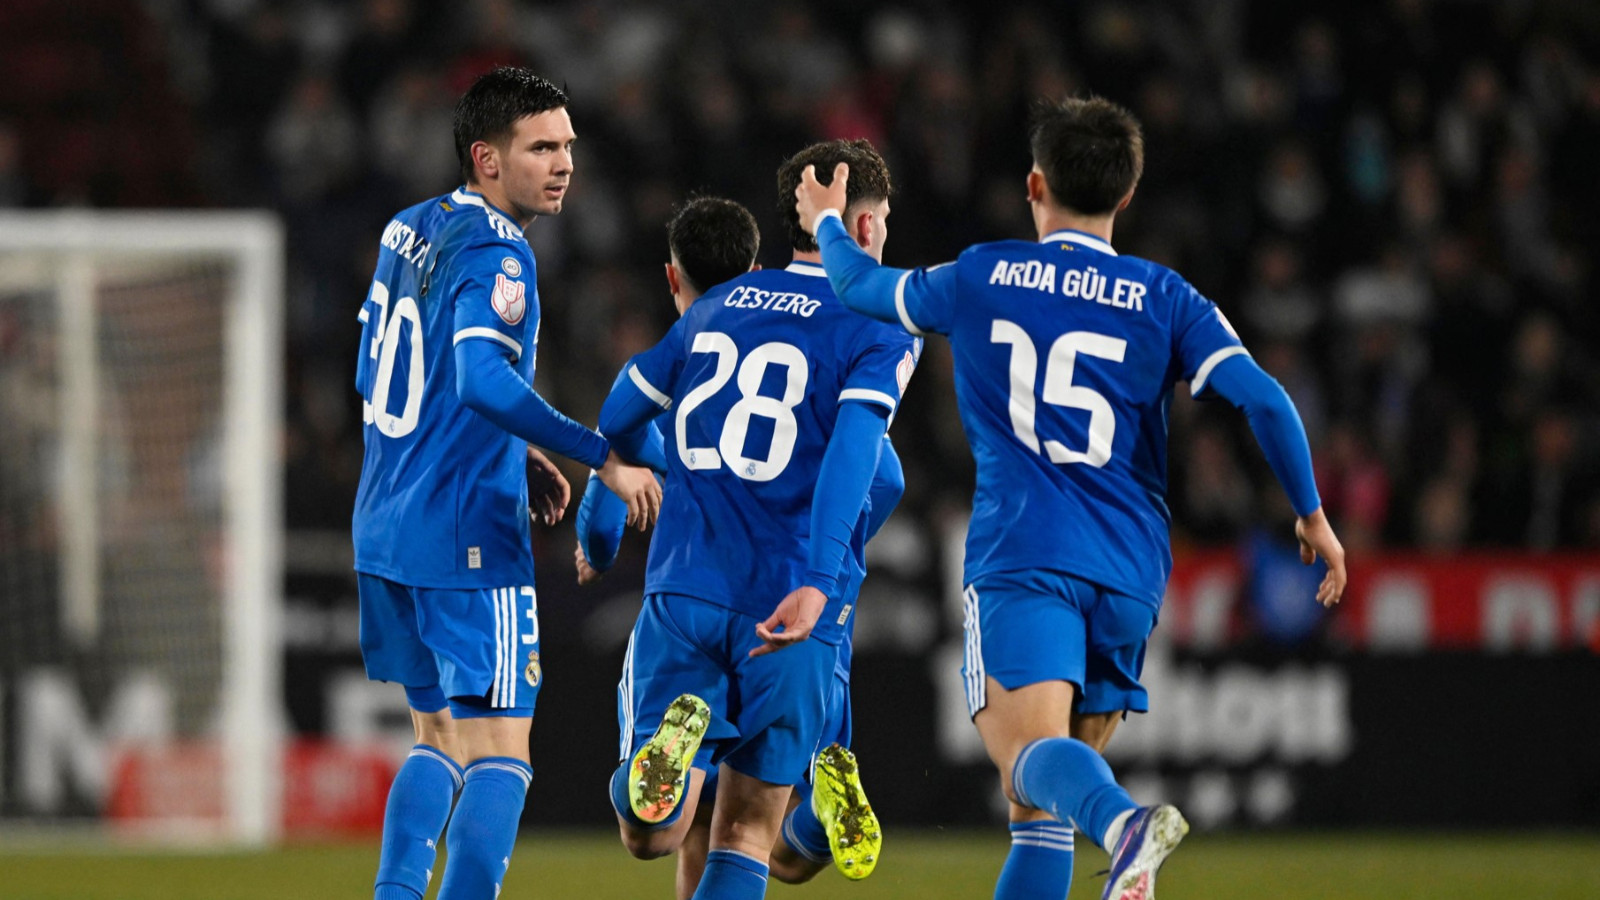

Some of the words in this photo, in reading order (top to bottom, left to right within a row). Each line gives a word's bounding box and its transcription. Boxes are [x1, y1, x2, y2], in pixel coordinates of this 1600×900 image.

[724, 286, 822, 318] CESTERO
[989, 259, 1056, 293] ARDA
[1062, 266, 1147, 312] GÜLER
[675, 331, 809, 482] 28
[990, 319, 1127, 468] 15
